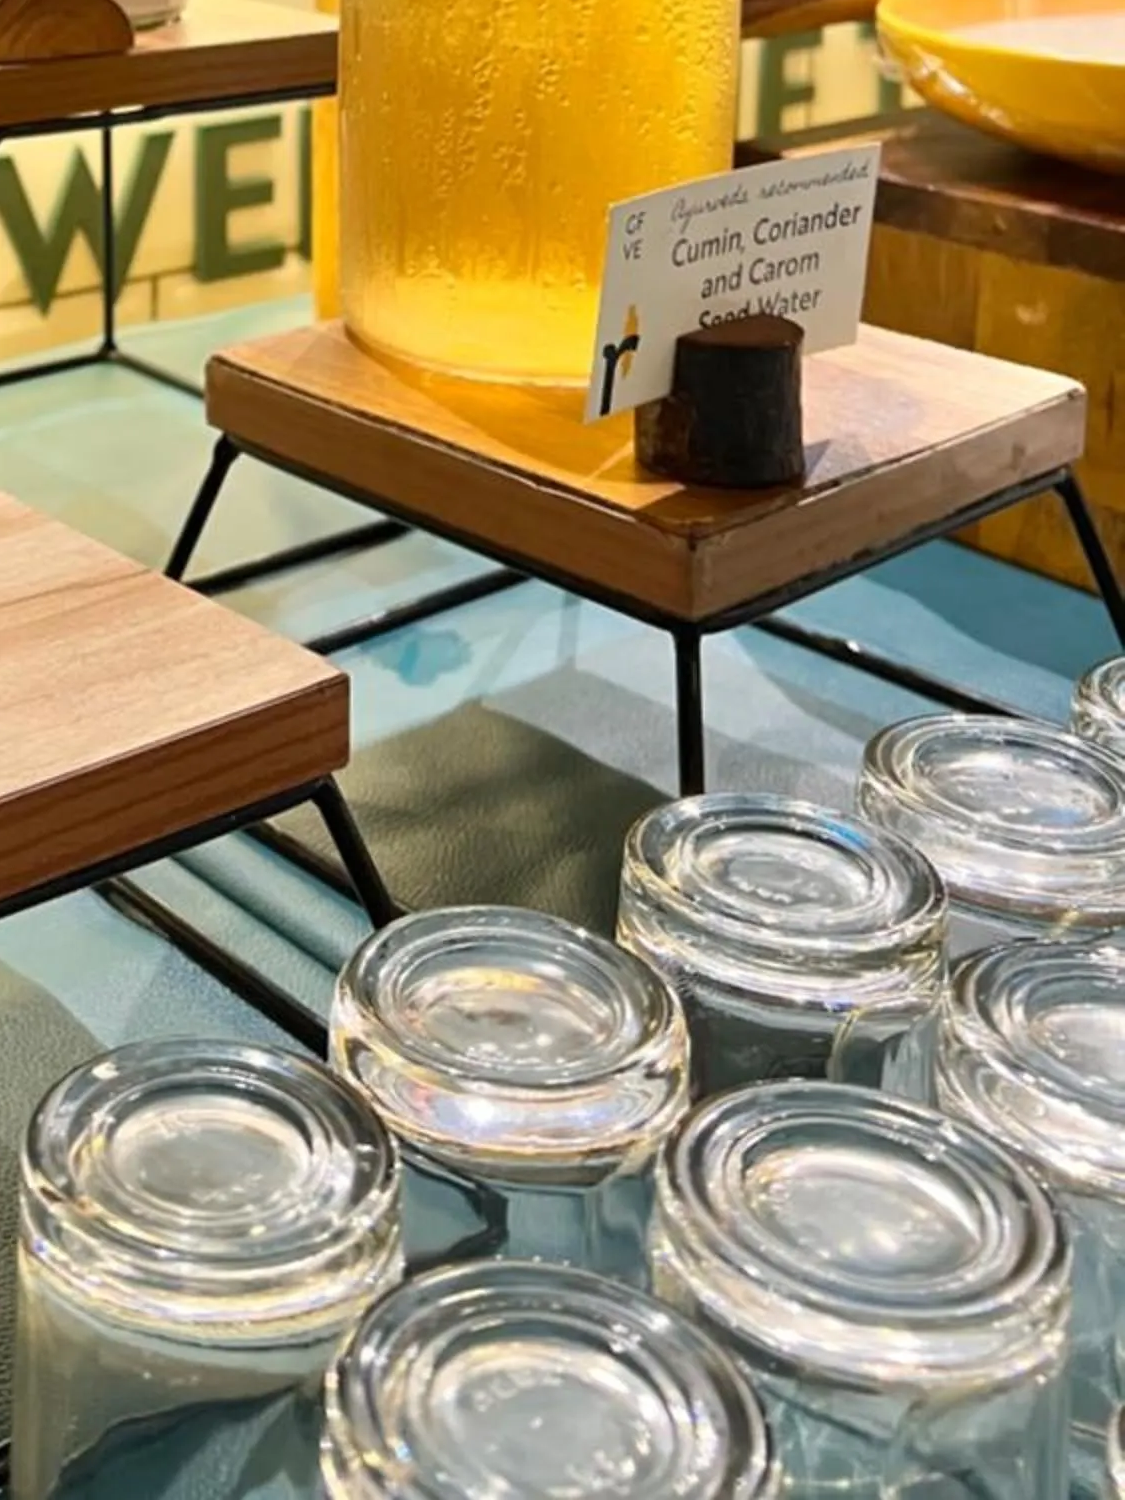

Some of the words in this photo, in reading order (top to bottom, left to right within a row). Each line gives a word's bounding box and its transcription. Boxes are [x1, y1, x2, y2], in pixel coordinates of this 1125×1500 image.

[758, 157, 871, 198] recommended
[623, 240, 643, 260] VE
[671, 229, 746, 267] Cumin,
[753, 202, 862, 246] Coriander
[701, 265, 743, 299] and
[748, 252, 820, 286] Carom
[758, 288, 822, 316] Water
